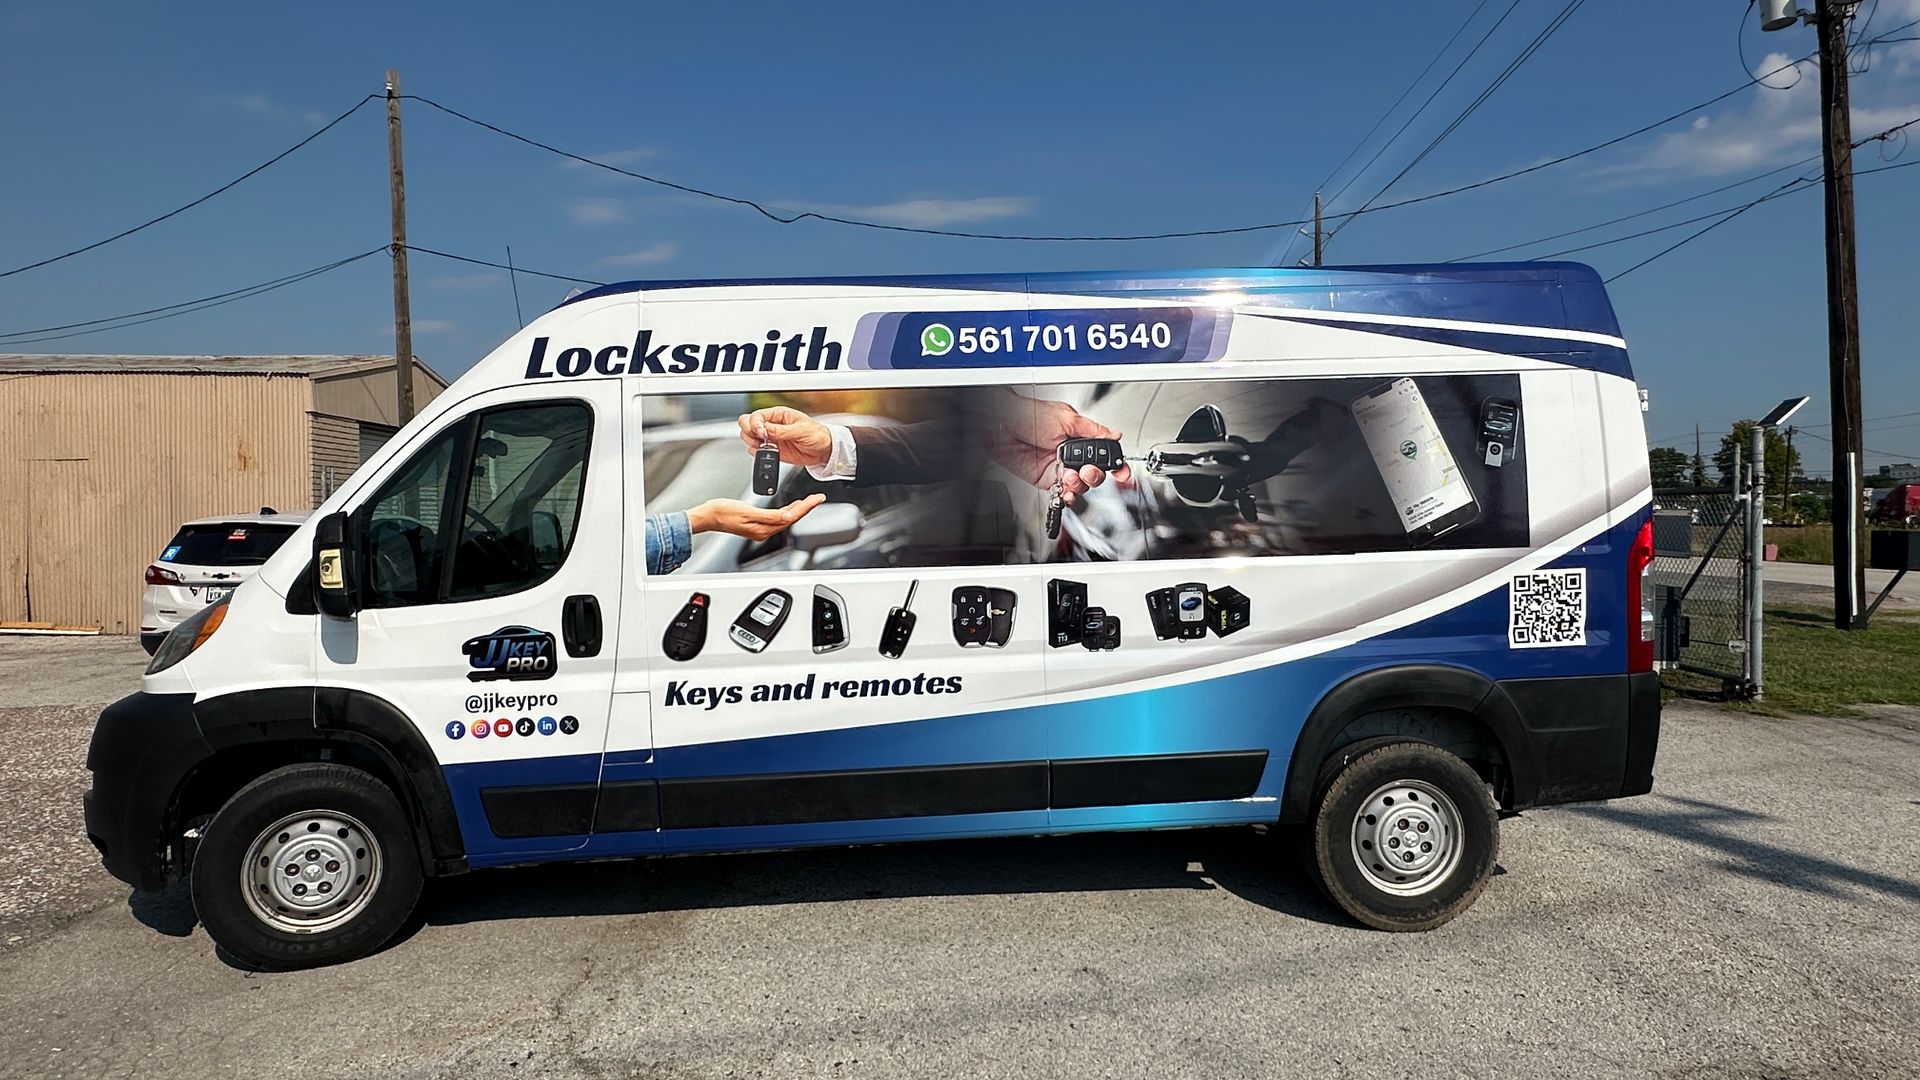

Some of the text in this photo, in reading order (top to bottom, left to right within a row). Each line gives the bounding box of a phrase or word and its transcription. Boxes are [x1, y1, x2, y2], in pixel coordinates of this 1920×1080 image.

[524, 326, 842, 379] Locksmith
[959, 322, 1171, 354] 561 701 6540
[474, 639, 549, 667] JJ KEY
[506, 656, 549, 672] PRO
[465, 692, 558, 713] @jjkeypro
[664, 672, 963, 711] Keys and remotes
